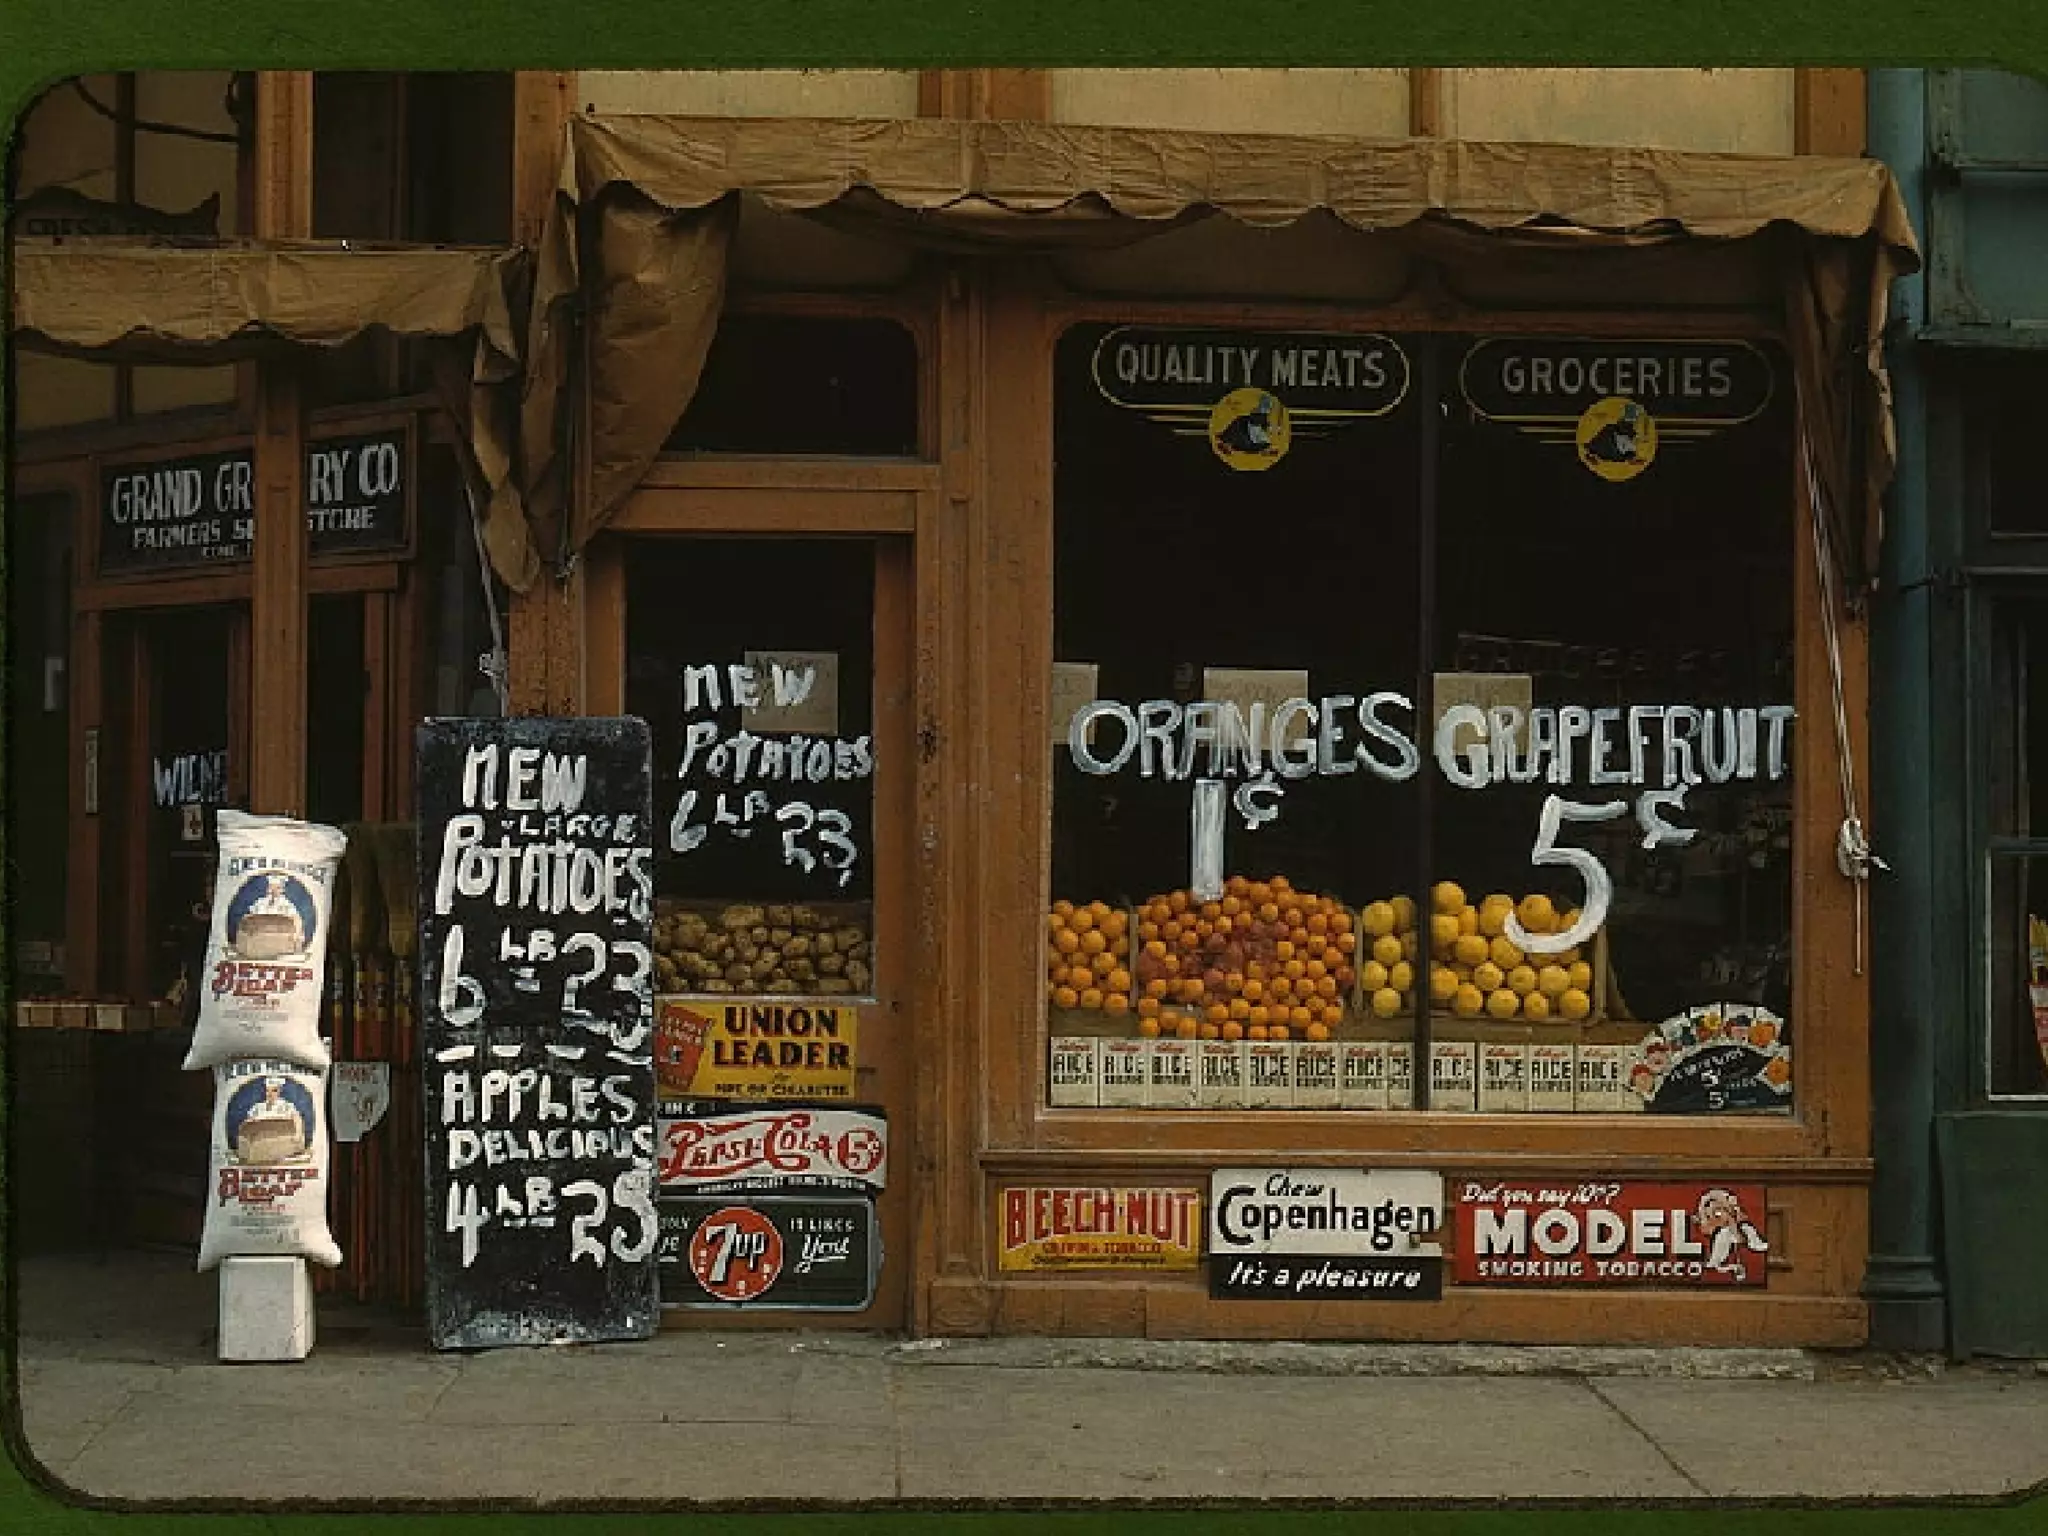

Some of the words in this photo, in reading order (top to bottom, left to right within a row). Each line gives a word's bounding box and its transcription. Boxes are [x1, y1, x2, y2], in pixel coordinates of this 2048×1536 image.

[1117, 344, 1261, 387] QUALITY
[1270, 349, 1387, 389] MEATS
[1503, 356, 1733, 398] GROCERIES
[110, 468, 202, 525] GRAND
[132, 519, 222, 549] FARMERS
[682, 664, 816, 714] NEW
[678, 722, 873, 783] POTATOES
[1069, 692, 1421, 783] ORANGES
[1433, 703, 1798, 789] GRAPEFRUIT
[462, 743, 587, 813] NEW
[670, 790, 707, 852] 6
[775, 801, 859, 876] 23
[435, 814, 653, 922] POTATOES
[440, 925, 486, 1027] 6
[560, 932, 653, 1050] 23
[725, 1006, 838, 1037] UNION
[713, 1040, 850, 1069] LEADER
[443, 1069, 637, 1124] APPLES
[1265, 1174, 1325, 1197] Chew
[446, 1180, 490, 1267] 4
[1003, 1187, 1198, 1250] BEECH-NUT
[1217, 1184, 1436, 1251] Copenhagen
[1474, 1209, 1703, 1256] MODEL
[1228, 1262, 1262, 1286] It's
[1273, 1268, 1290, 1286] a
[1296, 1262, 1421, 1292] pleasure
[1478, 1261, 1583, 1277] SMOKING
[1596, 1261, 1703, 1277] TOBACCO
